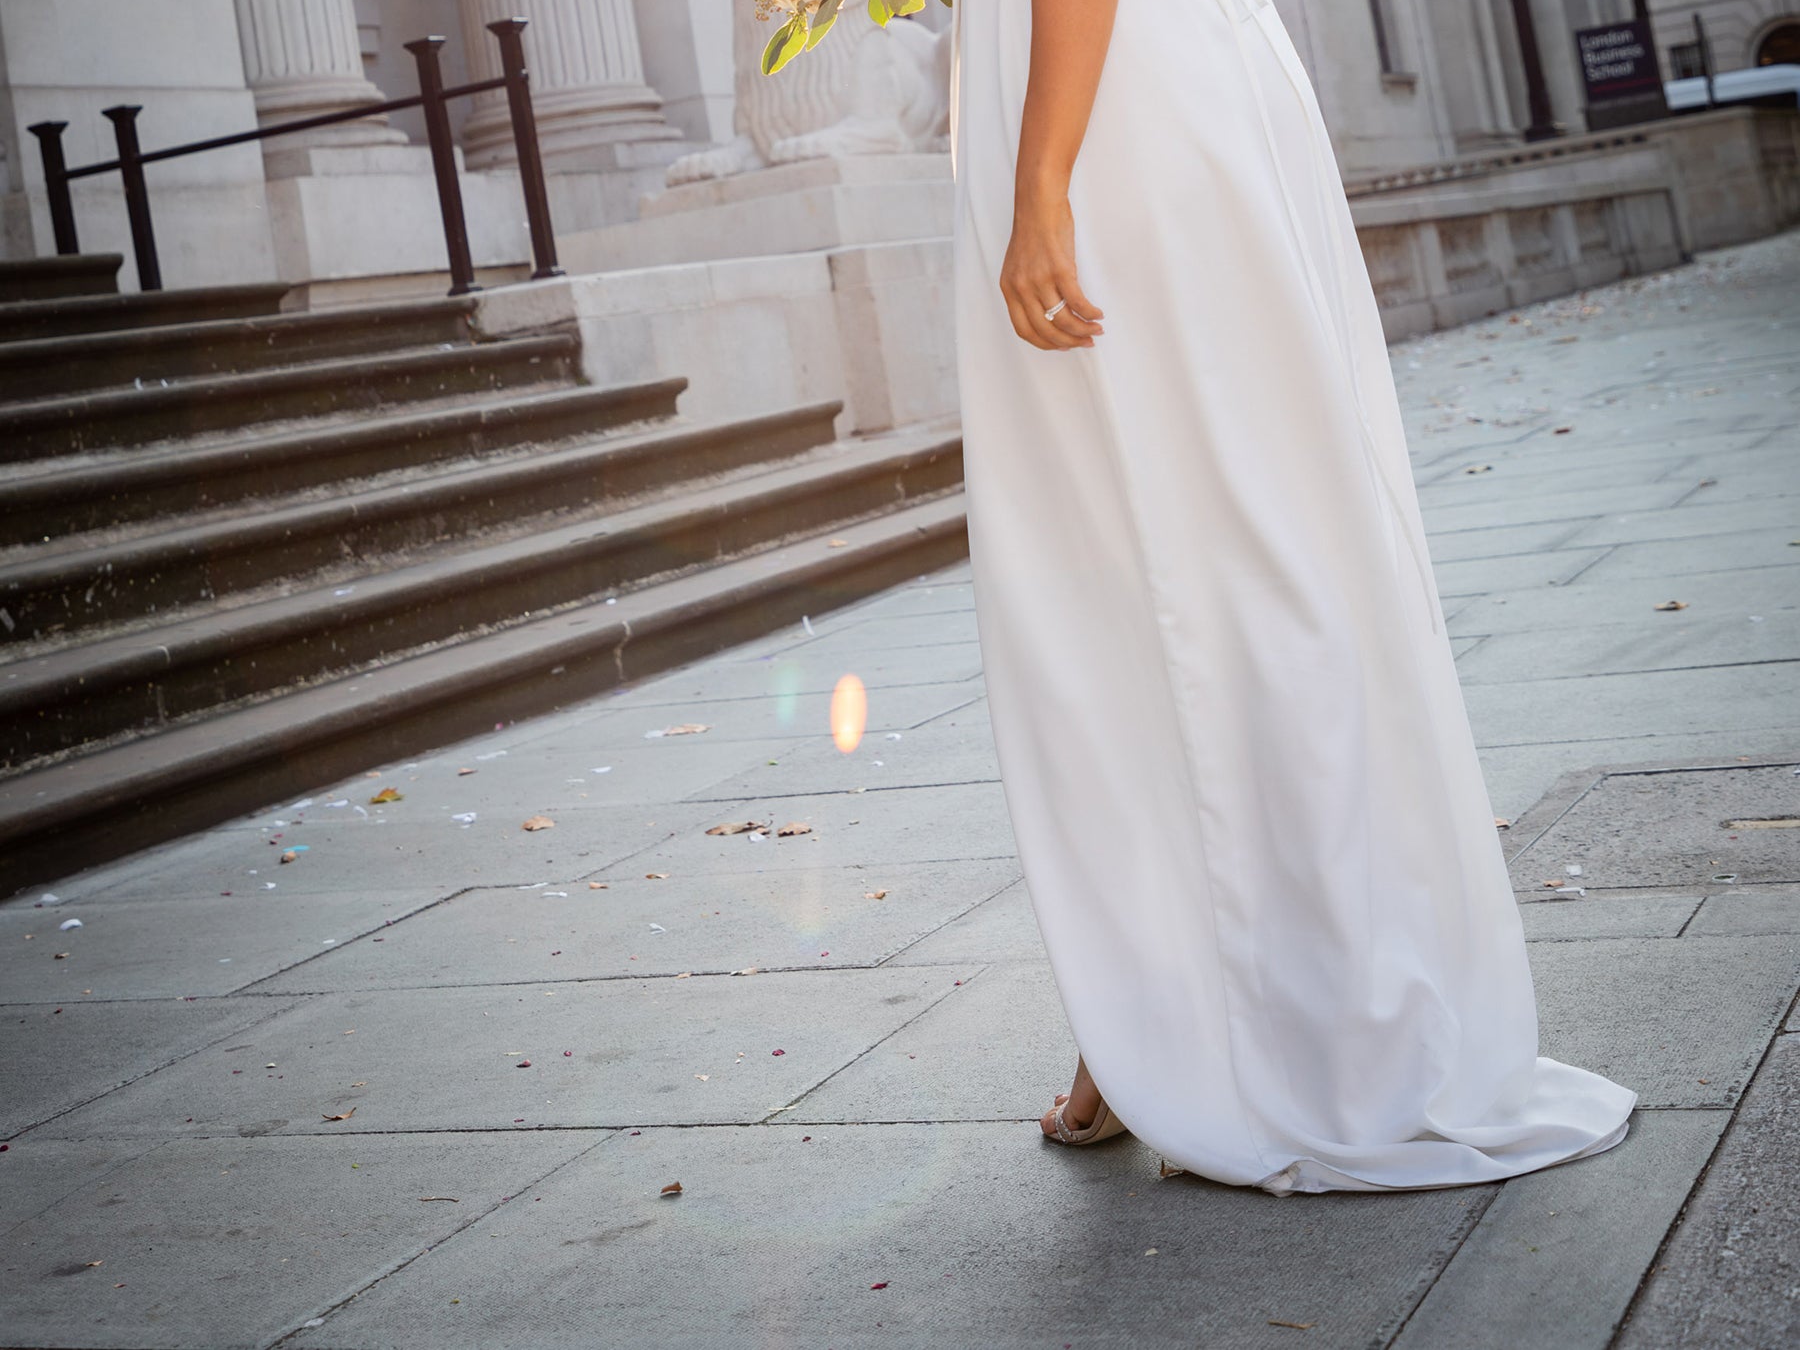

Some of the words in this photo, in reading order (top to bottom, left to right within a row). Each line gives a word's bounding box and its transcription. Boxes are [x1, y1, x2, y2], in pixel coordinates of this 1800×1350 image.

[1580, 29, 1634, 49] London
[1583, 43, 1645, 65] Business
[1586, 61, 1635, 81] School
